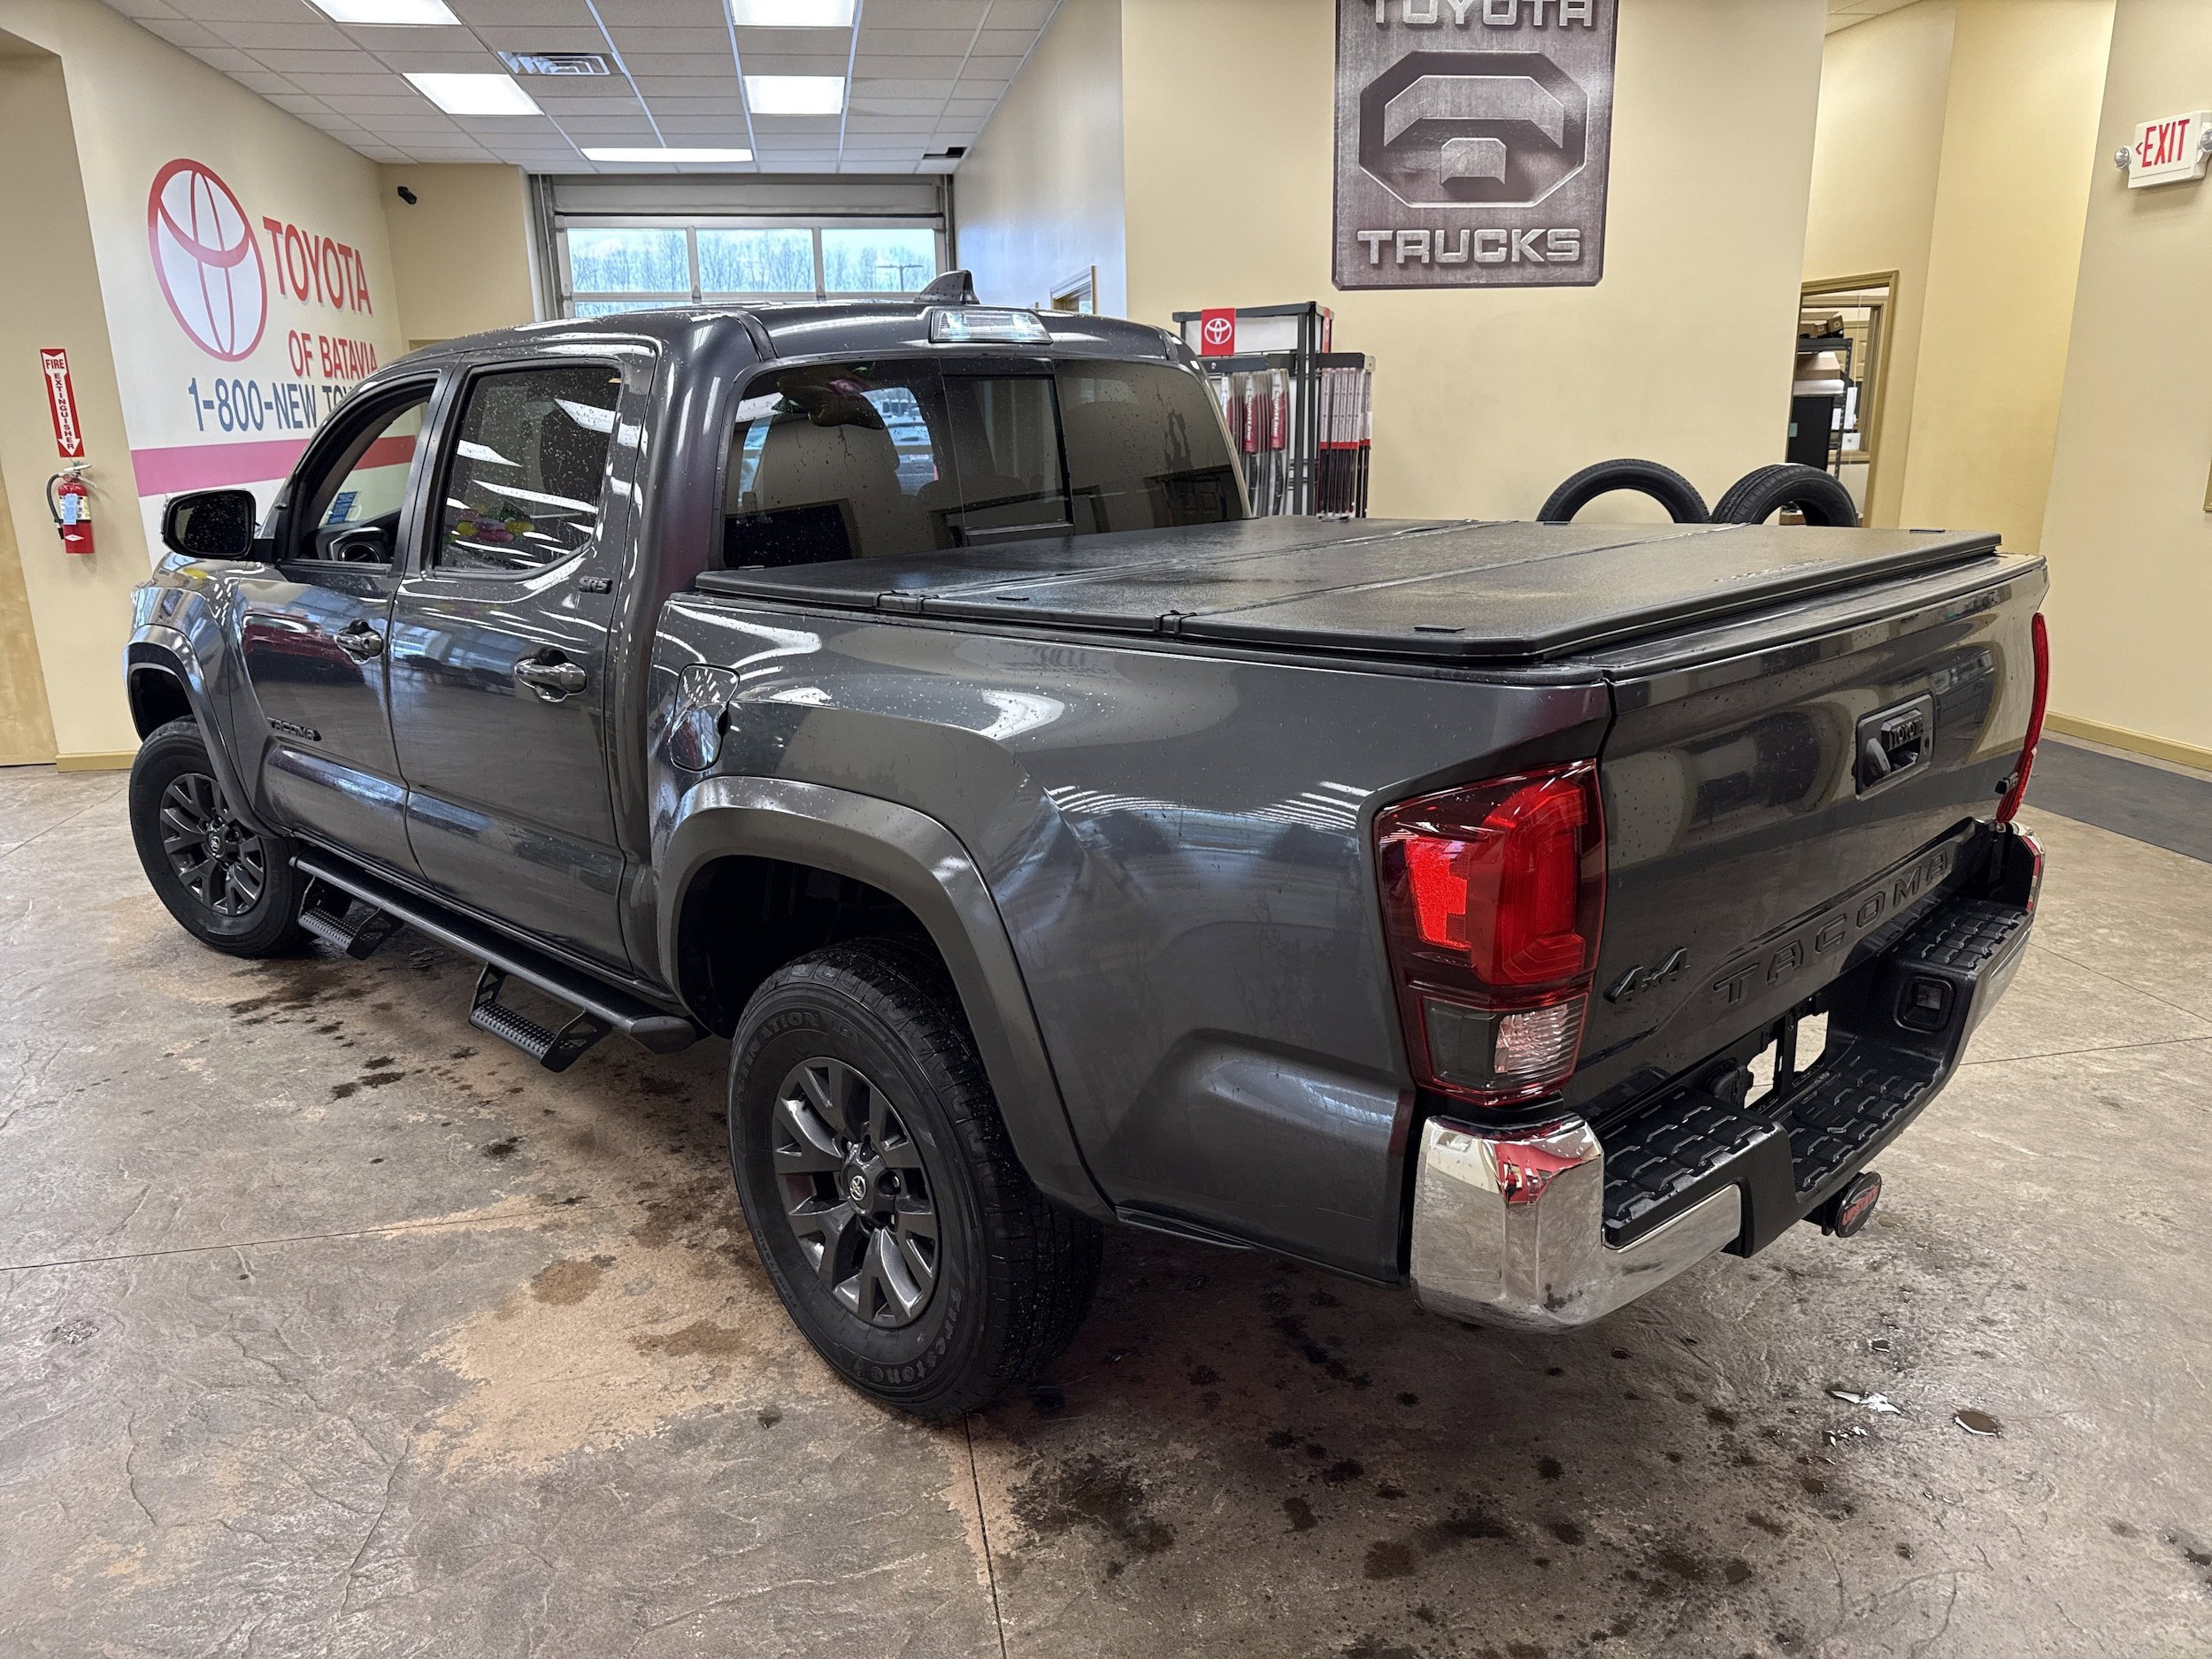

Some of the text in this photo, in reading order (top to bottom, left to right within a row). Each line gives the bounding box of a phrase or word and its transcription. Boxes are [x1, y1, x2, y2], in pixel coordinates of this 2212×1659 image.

[2142, 119, 2191, 167] EXIT
[262, 215, 373, 316] TOYOTA
[1356, 228, 1581, 265] TRUCKS
[45, 358, 65, 370] FIRE
[288, 329, 378, 380] OF BATAVIA
[54, 373, 75, 449] EXTINGUISHER
[188, 377, 318, 433] 1-800-NEW
[579, 575, 612, 594] SR5
[1889, 717, 1924, 749] TOYOTA
[1712, 850, 1948, 1005] TACOMA
